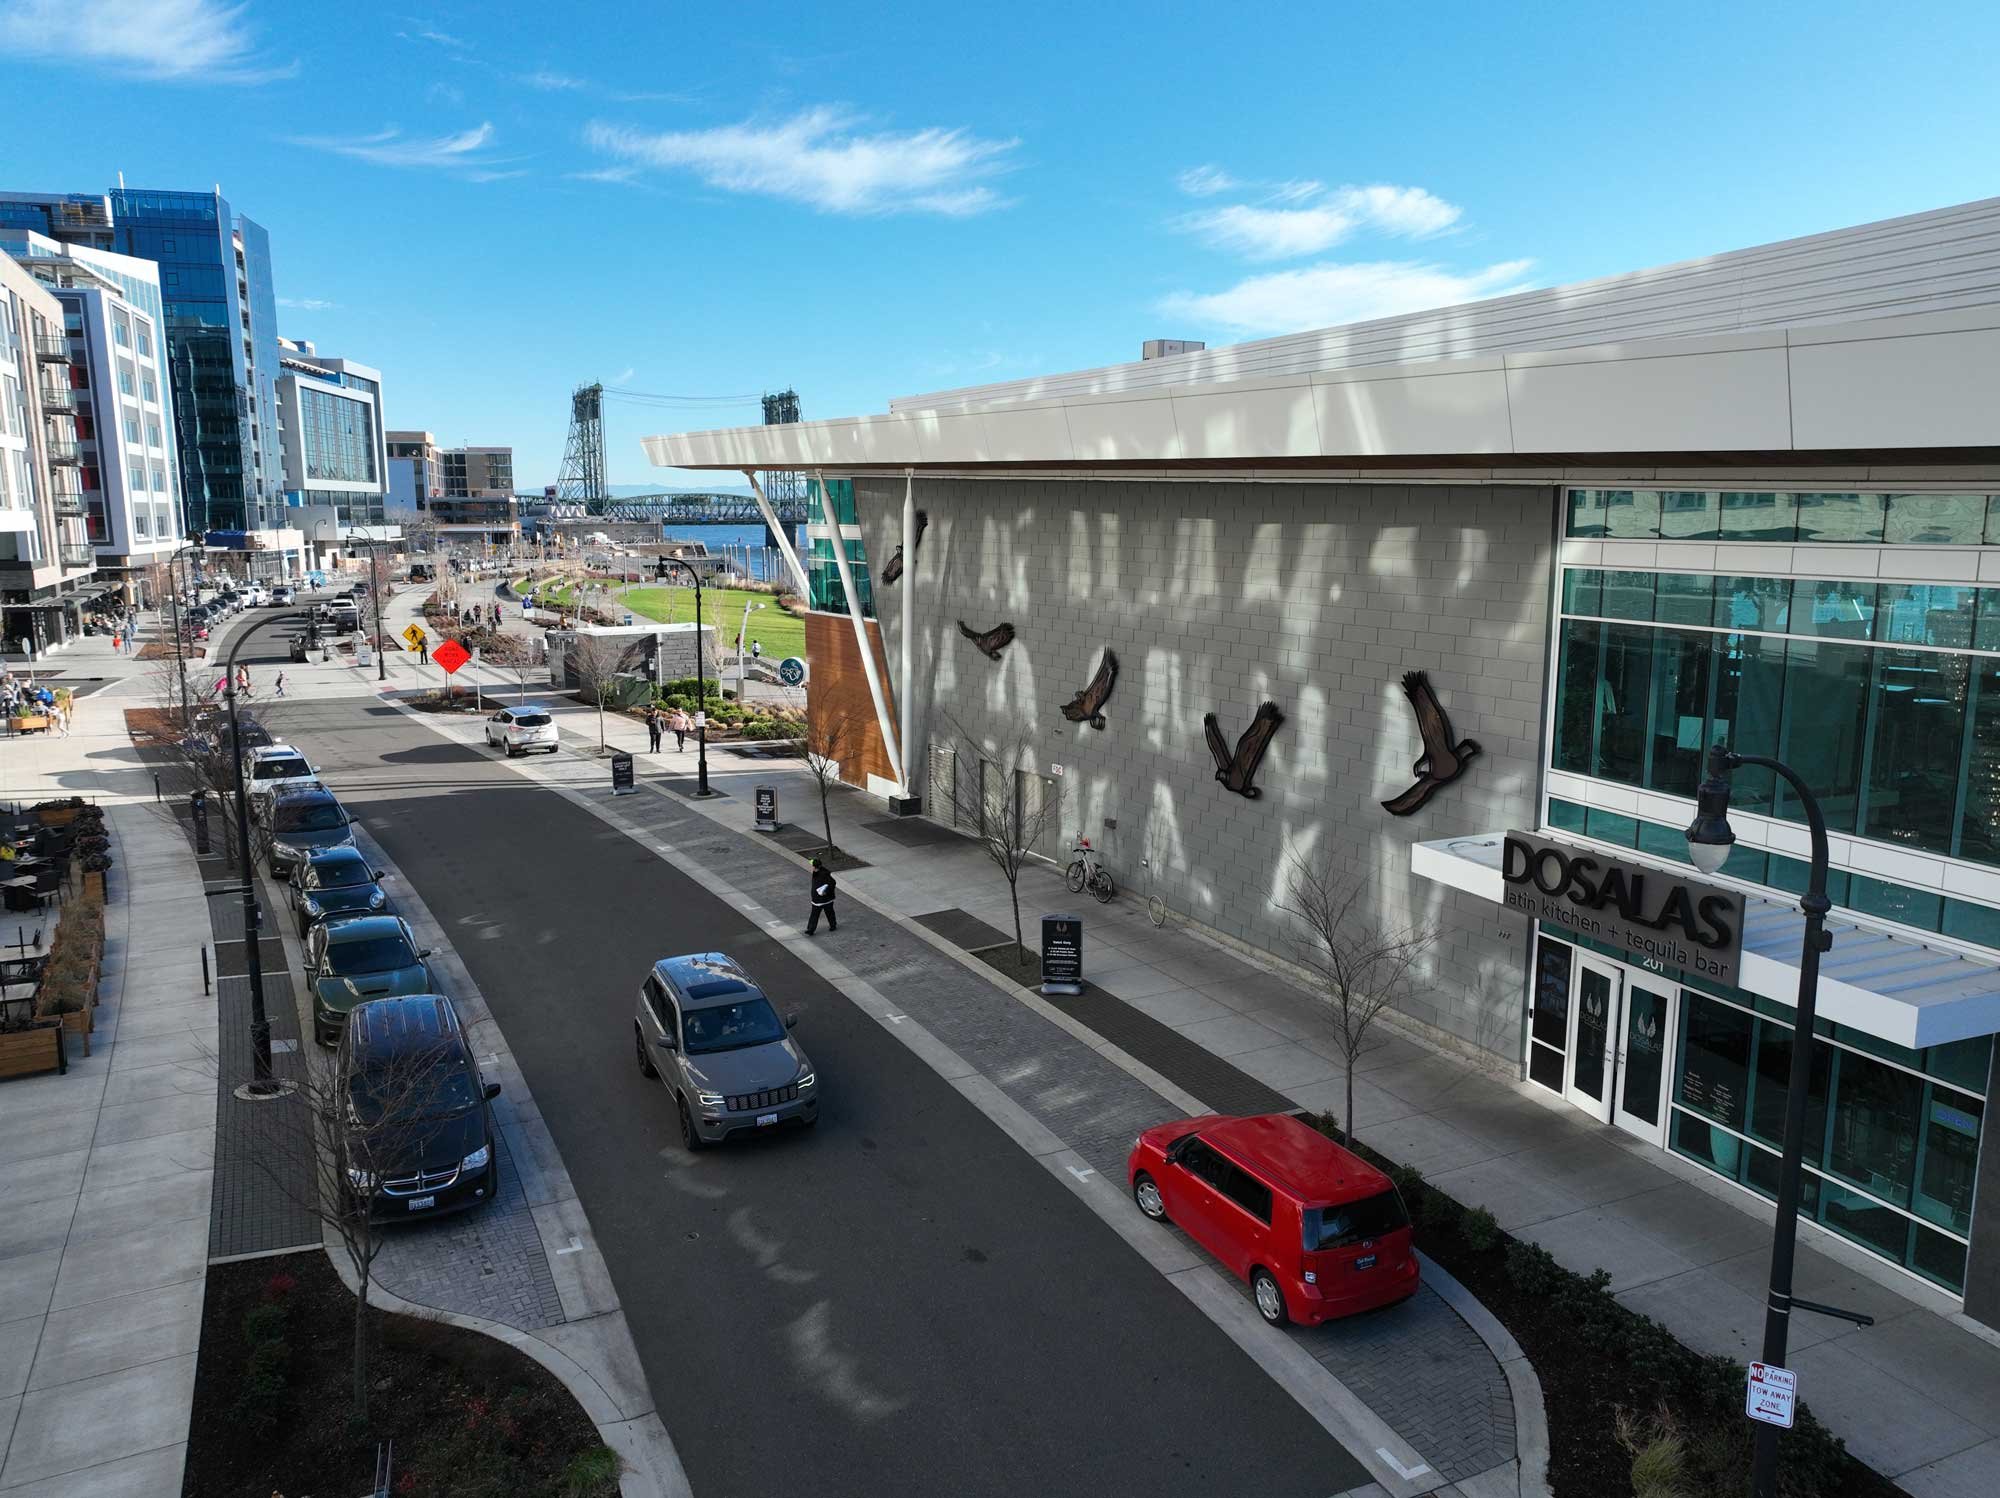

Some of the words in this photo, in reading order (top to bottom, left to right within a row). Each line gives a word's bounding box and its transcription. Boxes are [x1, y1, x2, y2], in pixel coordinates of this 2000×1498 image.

[1503, 837, 1736, 949] DOSALAS
[1505, 886, 1536, 911] latin
[1541, 897, 1601, 934] kitchen
[1608, 925, 1621, 938] +
[1626, 928, 1688, 965] tequila
[1695, 949, 1729, 977] bar
[1642, 955, 1664, 973] 201
[1751, 1366, 1763, 1379] NO
[1765, 1372, 1792, 1385] PARKING
[1752, 1385, 1769, 1396] TOW
[1770, 1391, 1791, 1402] AWAY
[1760, 1399, 1780, 1410] ZONE
